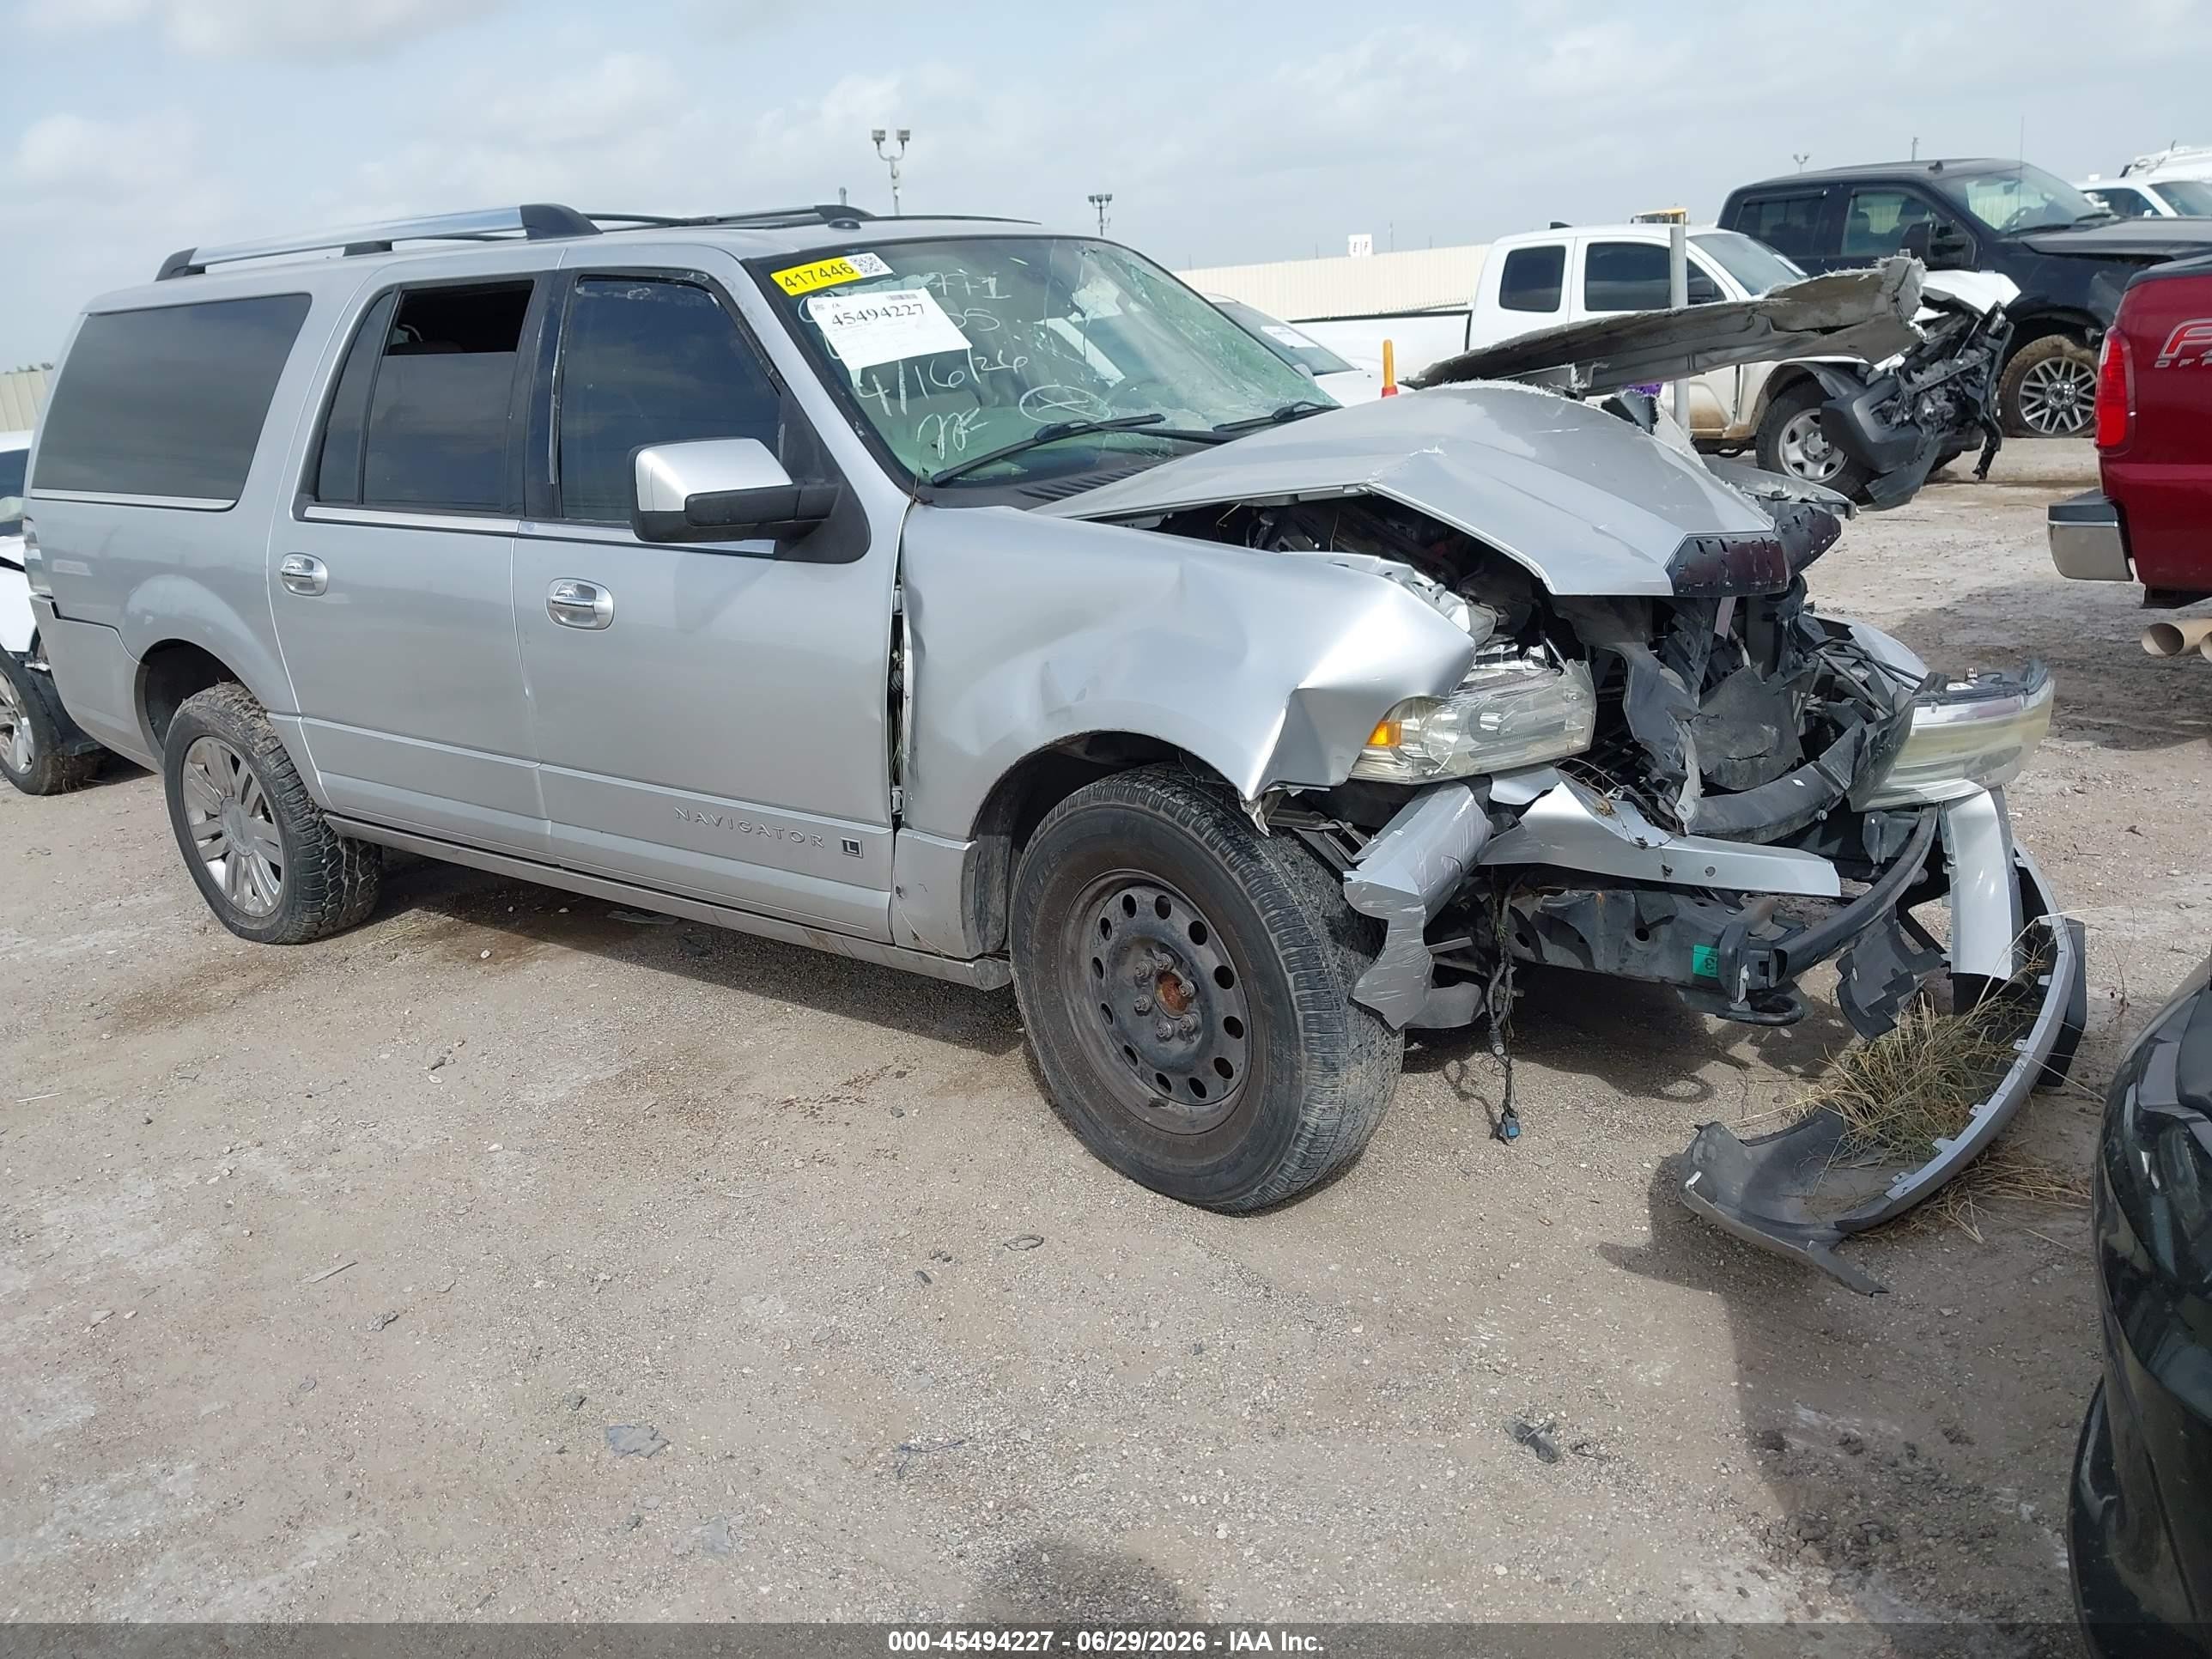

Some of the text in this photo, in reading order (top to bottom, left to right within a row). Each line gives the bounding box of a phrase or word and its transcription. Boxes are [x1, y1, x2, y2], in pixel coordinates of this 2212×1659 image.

[784, 262, 855, 289] 417446
[831, 302, 926, 326] 45494227
[674, 806, 825, 848] NAVIGATOR
